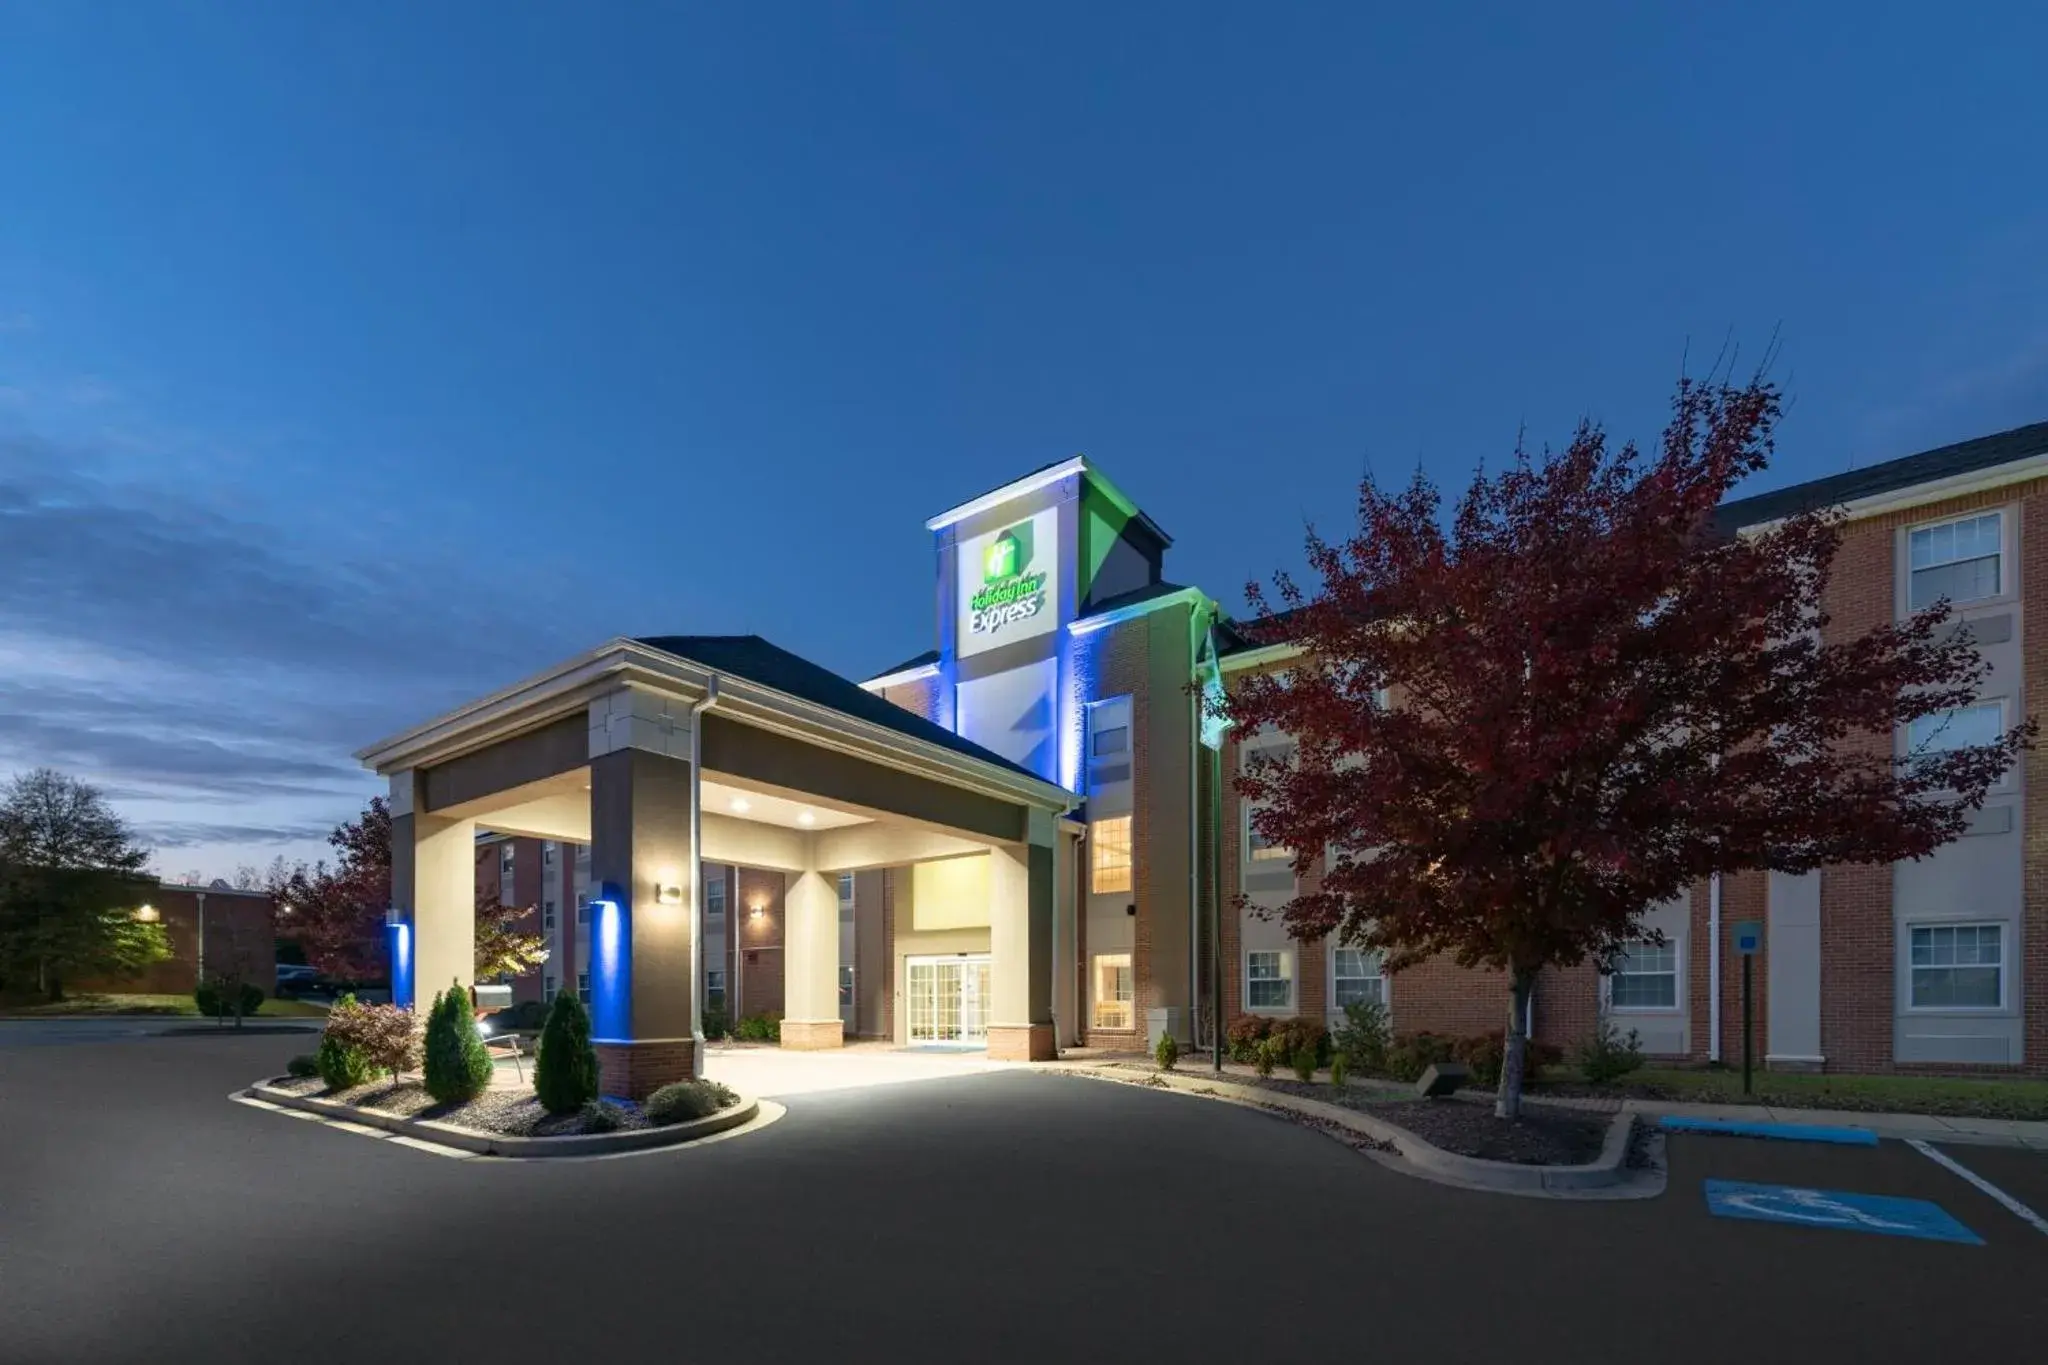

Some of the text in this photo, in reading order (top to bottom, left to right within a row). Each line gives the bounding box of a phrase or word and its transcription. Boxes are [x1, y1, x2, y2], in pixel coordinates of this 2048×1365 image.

[970, 579, 1037, 610] Holiday Inn
[970, 596, 1037, 633] Express
